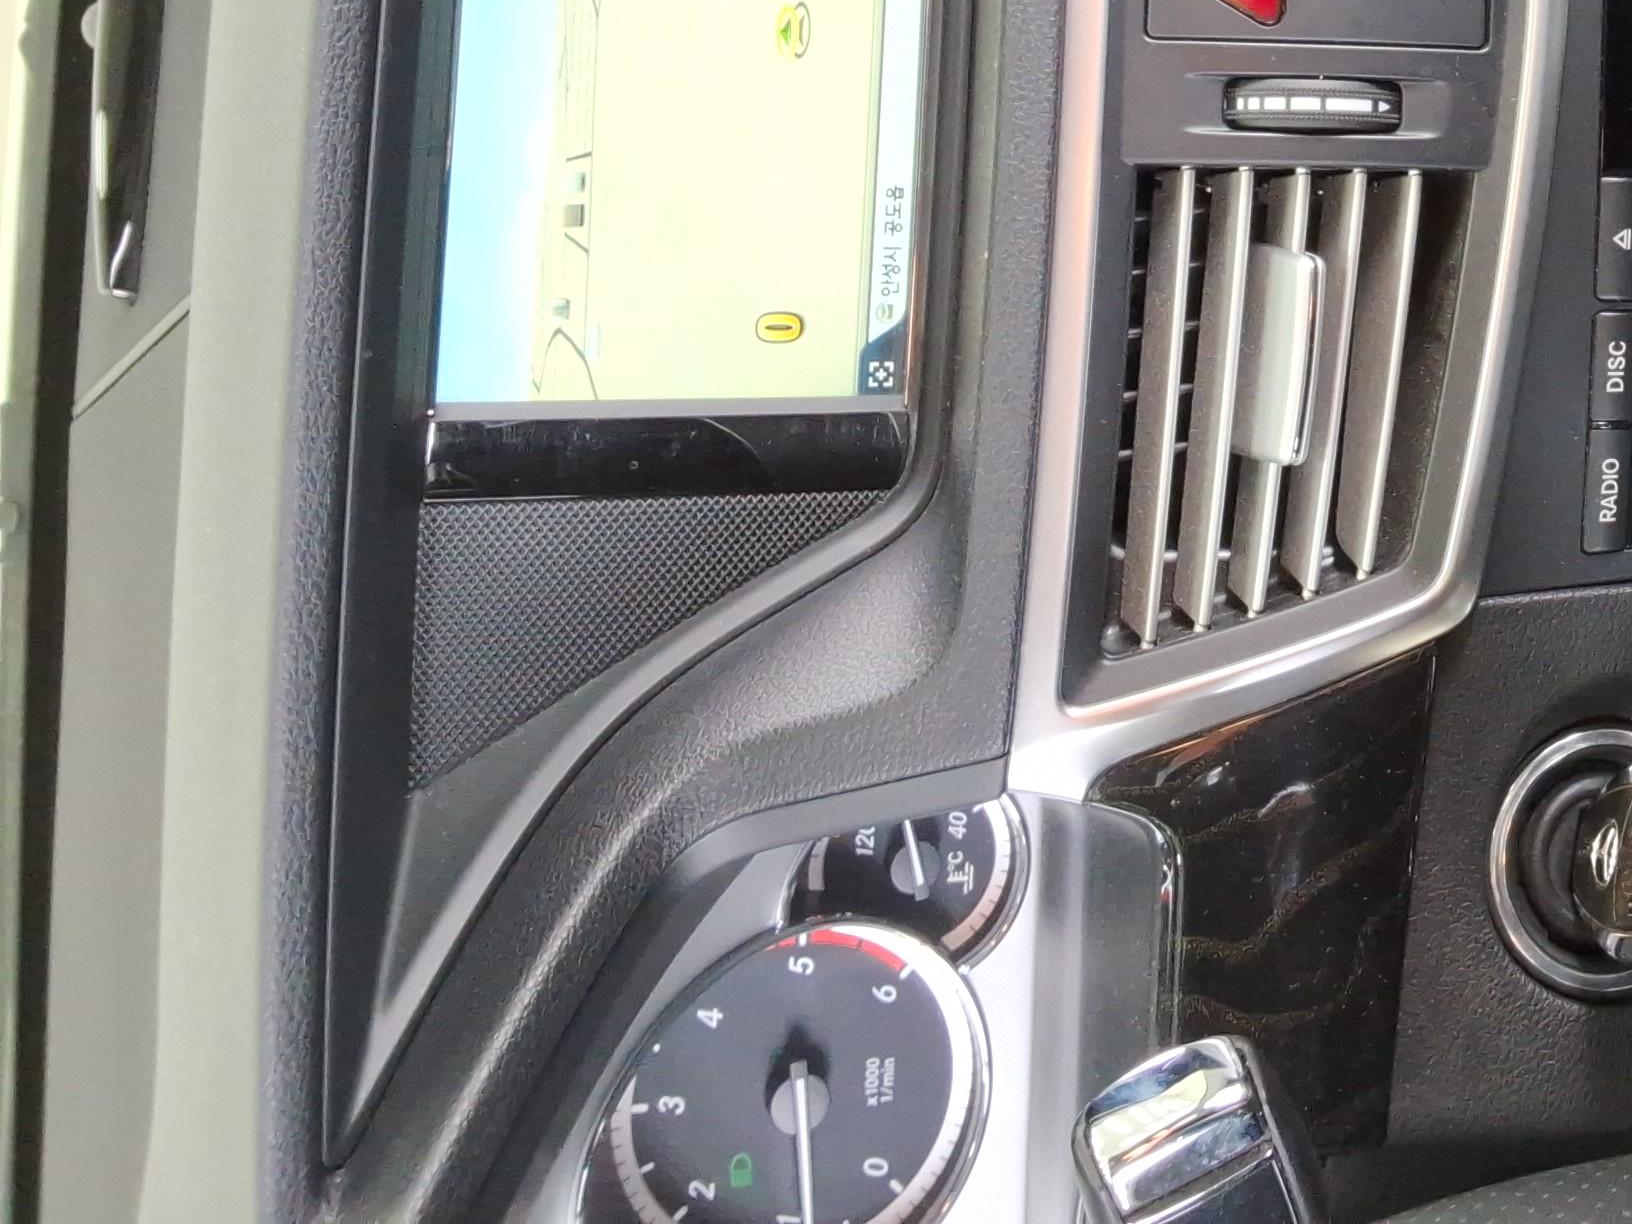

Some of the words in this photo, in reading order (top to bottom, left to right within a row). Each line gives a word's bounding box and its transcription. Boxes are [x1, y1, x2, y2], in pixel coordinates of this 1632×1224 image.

[883, 185, 905, 237] 공도읍
[880, 245, 903, 297] 안성시
[1606, 340, 1627, 394] DISC
[1598, 457, 1620, 523] RADIO
[947, 810, 968, 840] 40
[787, 956, 815, 976] 5
[871, 984, 898, 1004] 6
[696, 1007, 725, 1029] 4
[863, 1057, 881, 1107] x1000
[657, 1095, 686, 1116] 3
[863, 1156, 889, 1177] 0
[689, 1179, 716, 1201] 2
